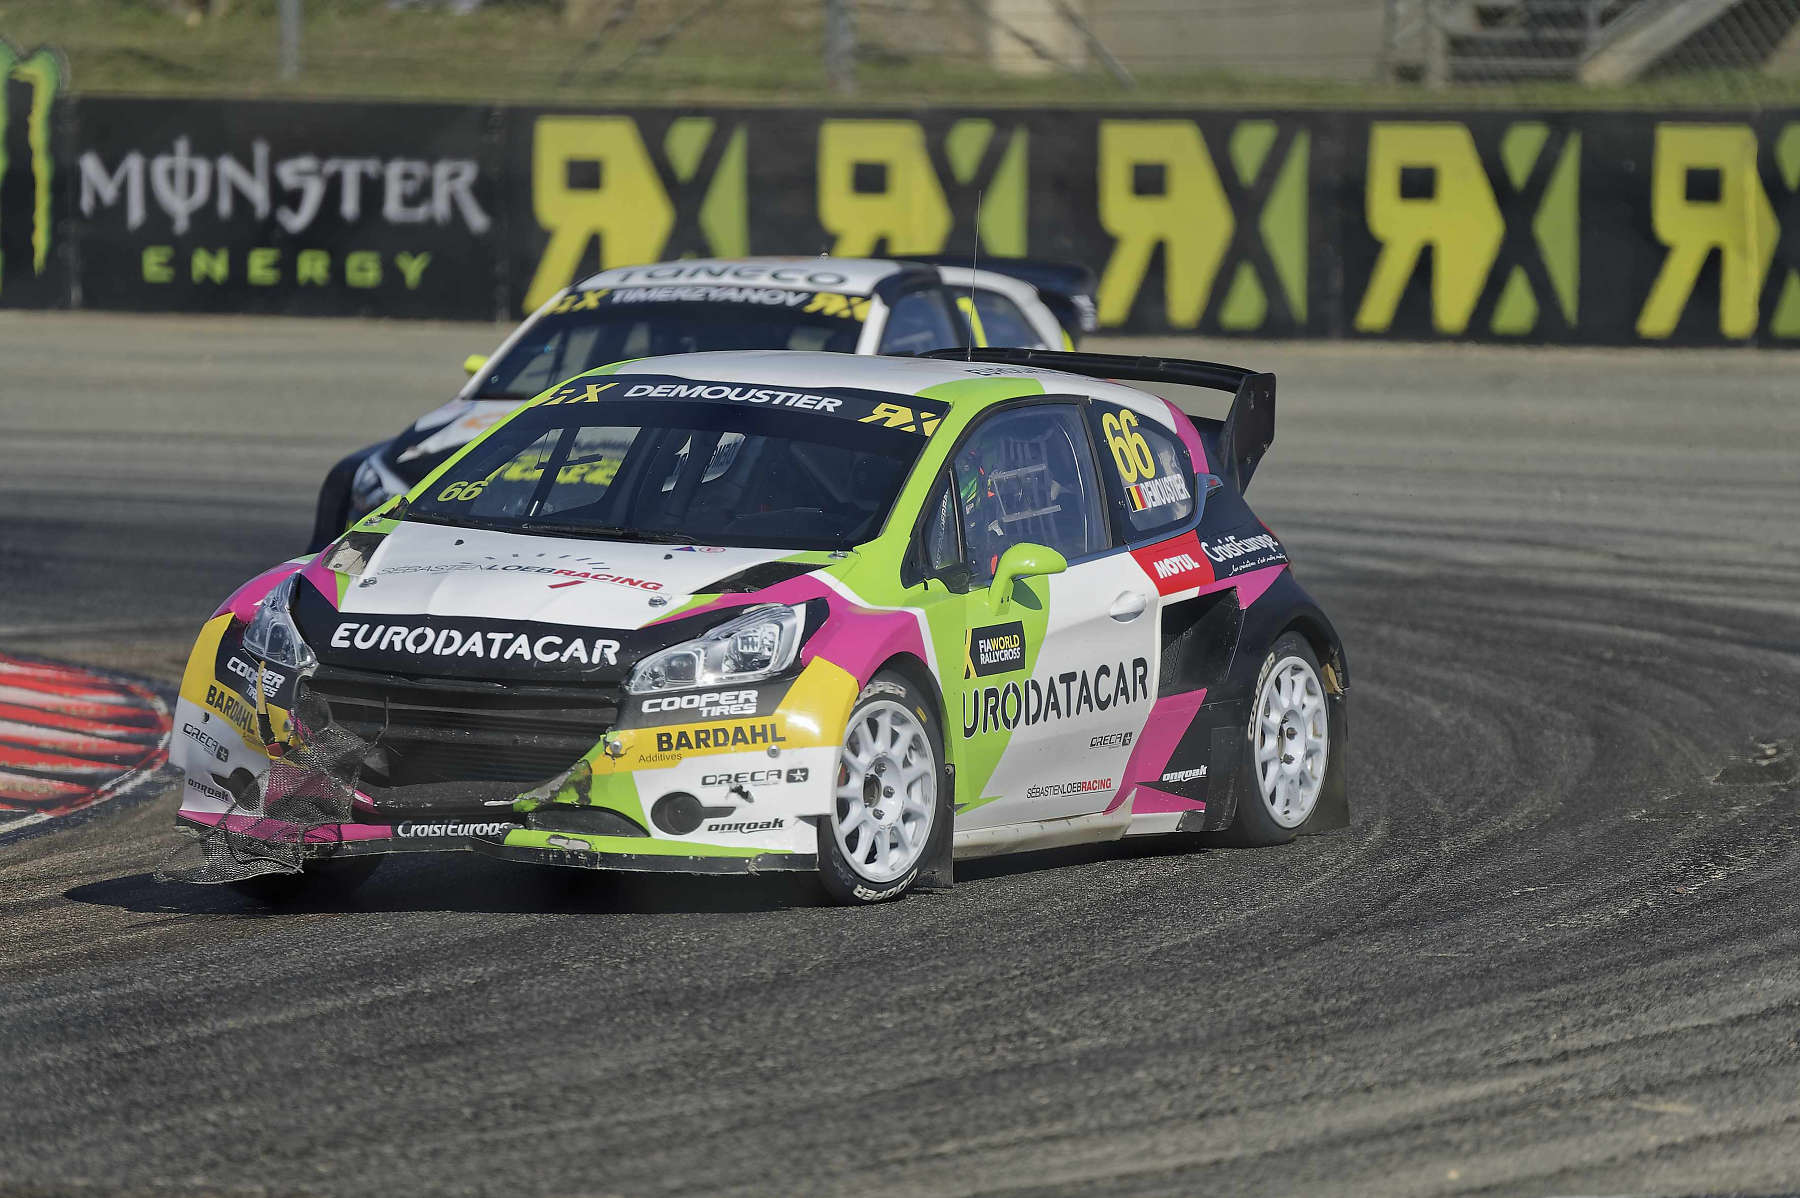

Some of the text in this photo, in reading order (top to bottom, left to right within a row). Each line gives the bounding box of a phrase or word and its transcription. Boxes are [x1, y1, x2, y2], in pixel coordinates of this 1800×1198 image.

[79, 134, 491, 236] MONSTER
[142, 245, 431, 290] ENERGY
[623, 384, 843, 413] DEMOUSTIER
[1102, 409, 1156, 483] 66
[437, 480, 489, 502] 66
[1153, 553, 1200, 579] MOTUL
[330, 621, 623, 667] EURODATACAR
[979, 647, 1022, 665] RALLYCROSS
[205, 684, 256, 735] BARDAHL
[641, 690, 758, 713] COOPER
[699, 703, 758, 718] TIRES
[656, 724, 787, 752] BARDAHL
[638, 752, 683, 764] Additives
[702, 769, 782, 787] ORECA
